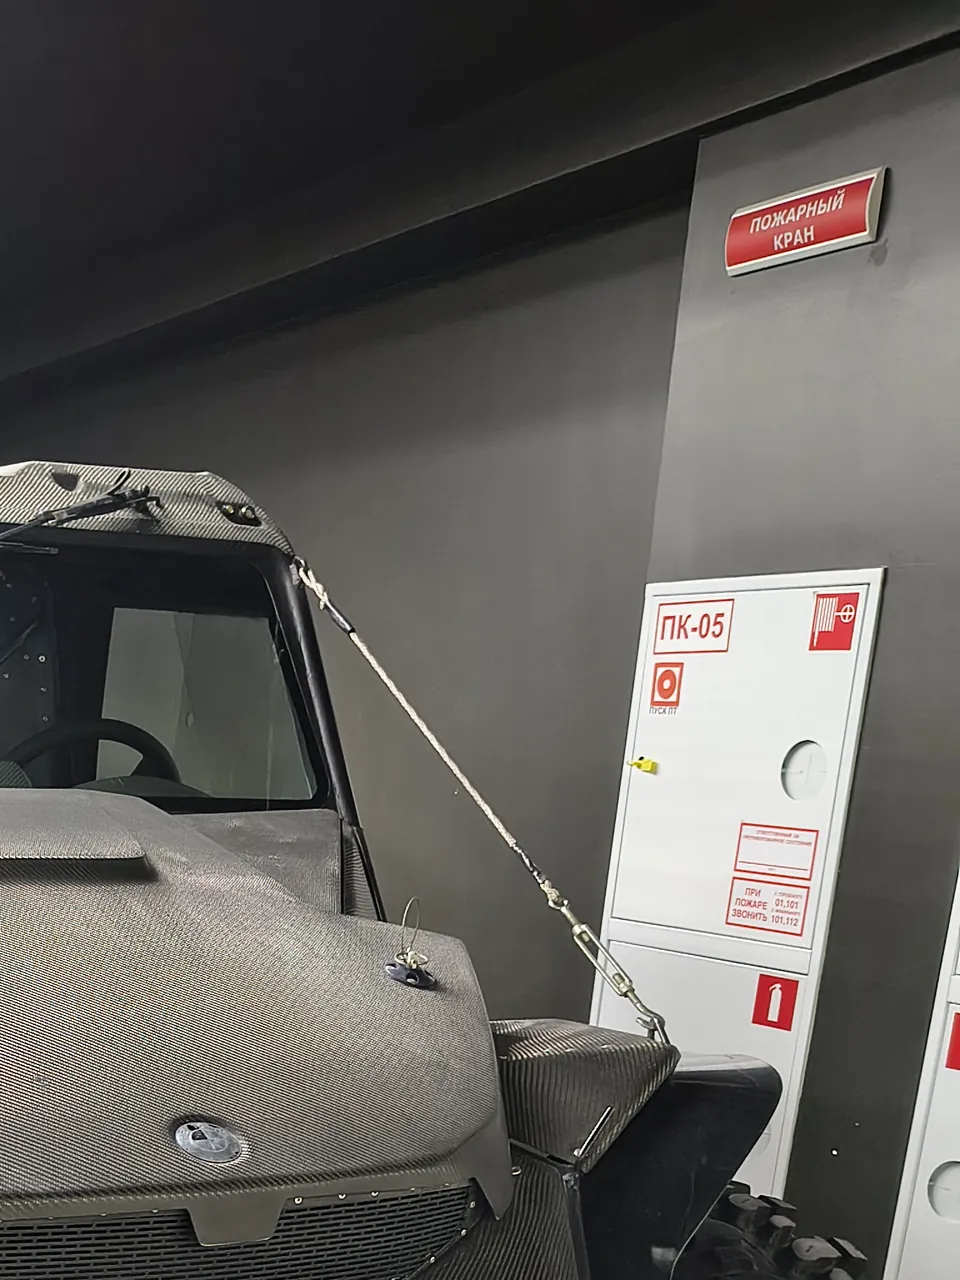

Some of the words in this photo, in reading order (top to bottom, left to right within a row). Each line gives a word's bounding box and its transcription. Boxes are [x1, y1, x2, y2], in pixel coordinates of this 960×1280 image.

[749, 188, 846, 234] ПОЖАРНЫЙ
[773, 225, 815, 251] КРАН
[660, 613, 725, 640] ПК-05
[649, 706, 667, 715] ПУСК
[668, 707, 678, 715] ПТ
[744, 887, 761, 897] ПРИ
[734, 897, 768, 910] ПОЖАРЕ
[774, 898, 799, 909] 01,101
[731, 908, 768, 922] ЗВОНИТЬ
[771, 914, 799, 927] 101,112
